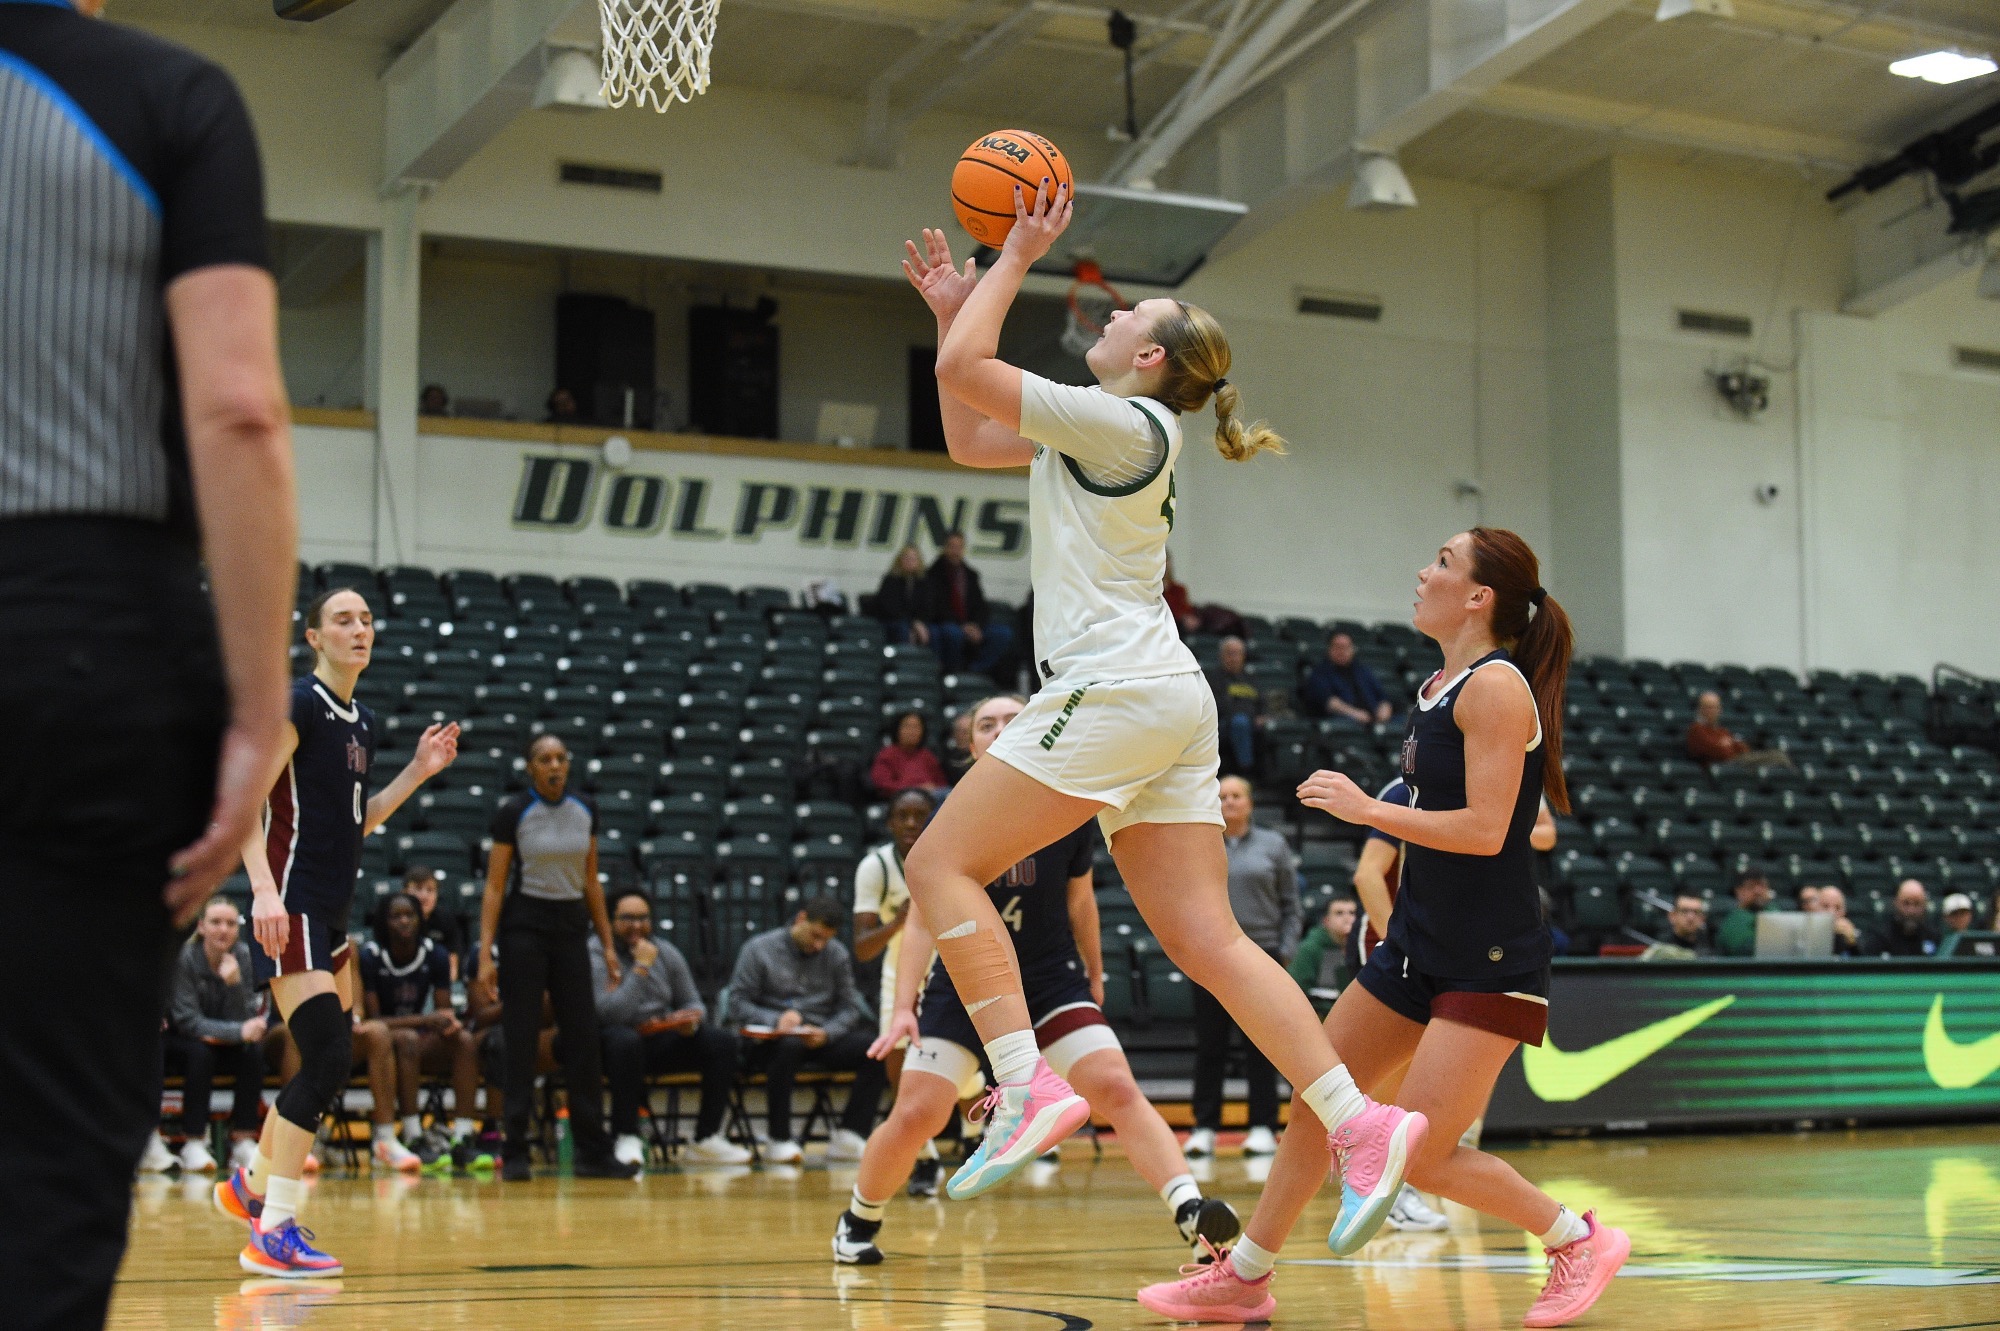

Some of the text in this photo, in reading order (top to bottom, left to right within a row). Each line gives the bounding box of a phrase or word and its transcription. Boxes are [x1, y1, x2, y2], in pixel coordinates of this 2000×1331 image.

[976, 136, 1031, 164] NCAA
[511, 453, 1030, 558] DOLPHINS
[1001, 895, 1023, 932] 4
